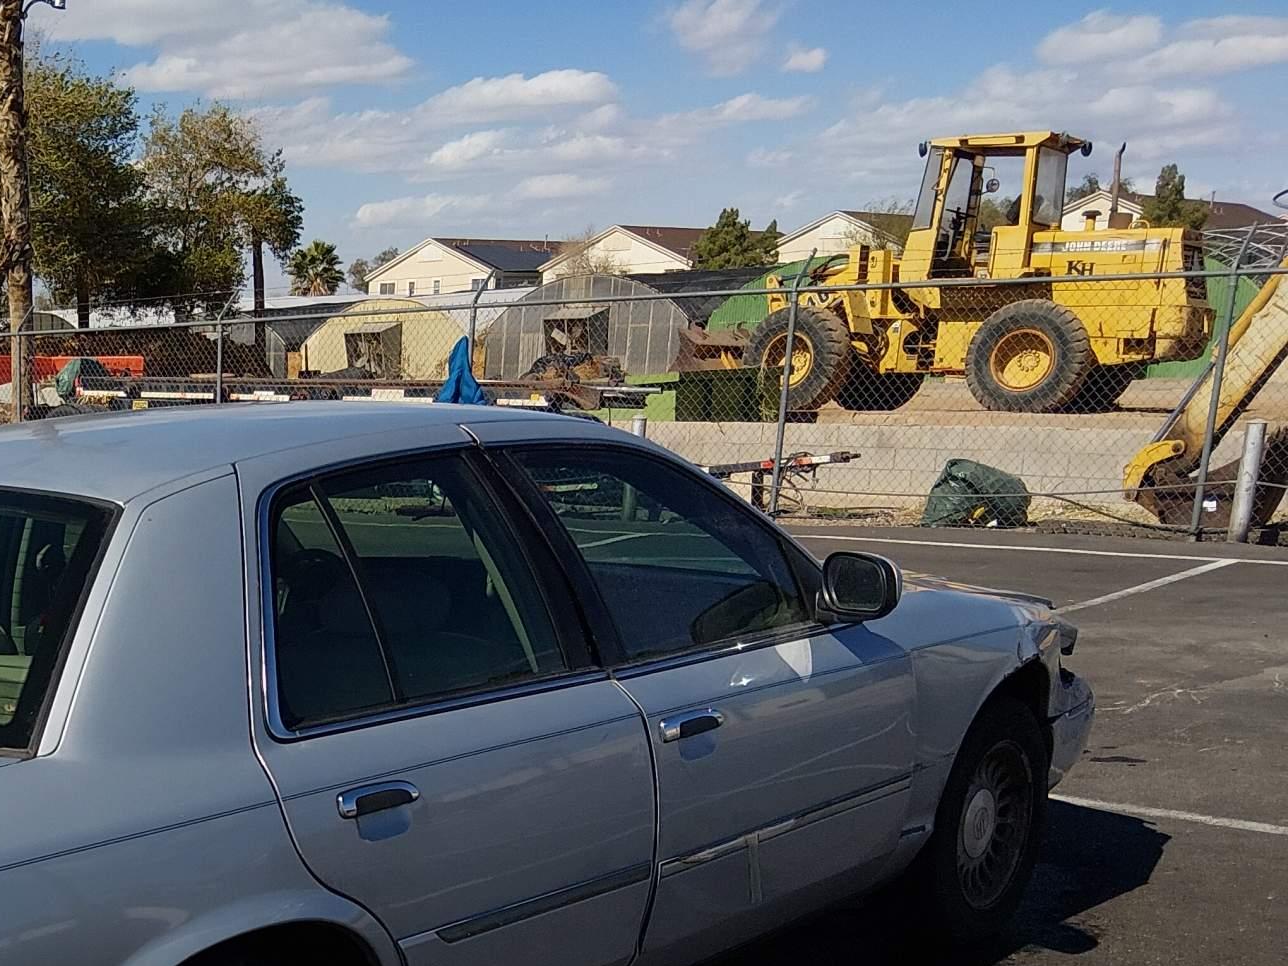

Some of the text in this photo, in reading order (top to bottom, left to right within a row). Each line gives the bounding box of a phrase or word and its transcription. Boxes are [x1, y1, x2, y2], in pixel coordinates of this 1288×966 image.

[1062, 240, 1127, 252] JOHN DEERE
[1065, 260, 1096, 276] KH
